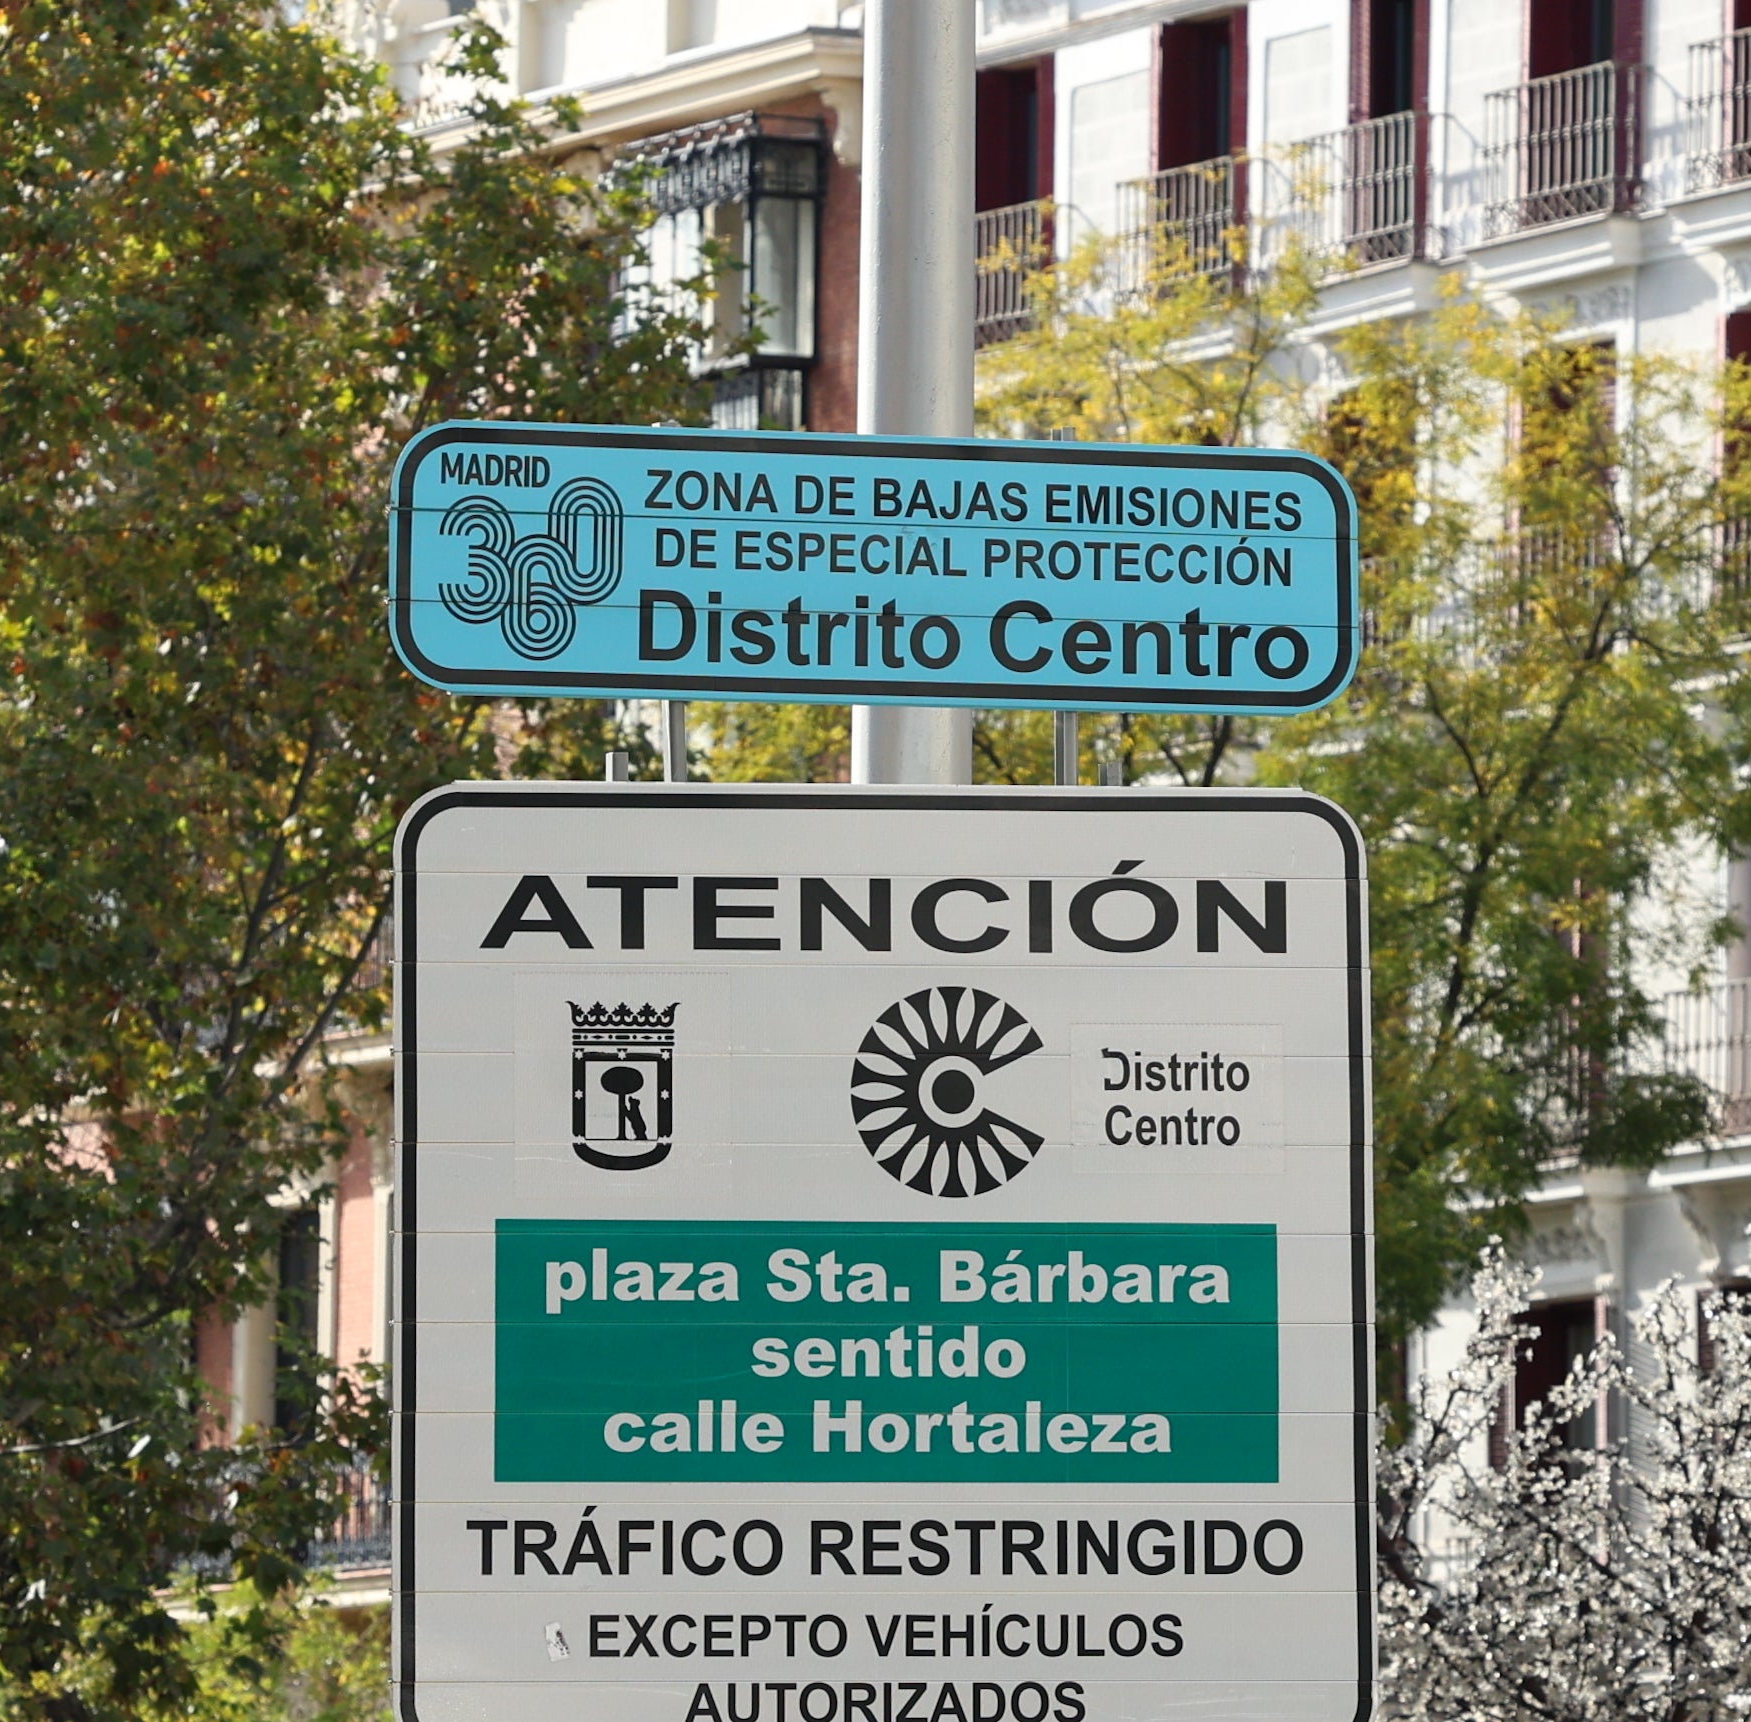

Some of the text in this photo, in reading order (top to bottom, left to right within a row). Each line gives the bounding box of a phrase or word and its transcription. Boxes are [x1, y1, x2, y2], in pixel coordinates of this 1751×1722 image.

[440, 451, 552, 489] MADRID
[644, 469, 1302, 532] ZONA DE BAJAS EMISIONES
[655, 527, 1291, 587] DE ESPECIAL PROTECCIÓN
[638, 589, 1309, 680] Distrito Centro
[481, 859, 1287, 954] ATENCIÓN
[1101, 1047, 1251, 1092] Distrito
[1104, 1104, 1242, 1147] Centro
[545, 1247, 1229, 1315] plaza Sta. Bárbara
[752, 1325, 1027, 1379] sentido
[603, 1399, 1171, 1454] calle Hortaleza
[466, 1505, 1303, 1576] TRÁFICO RESTRINGIDO
[589, 1603, 1185, 1658] EXCEPTO VEHÍCULOS
